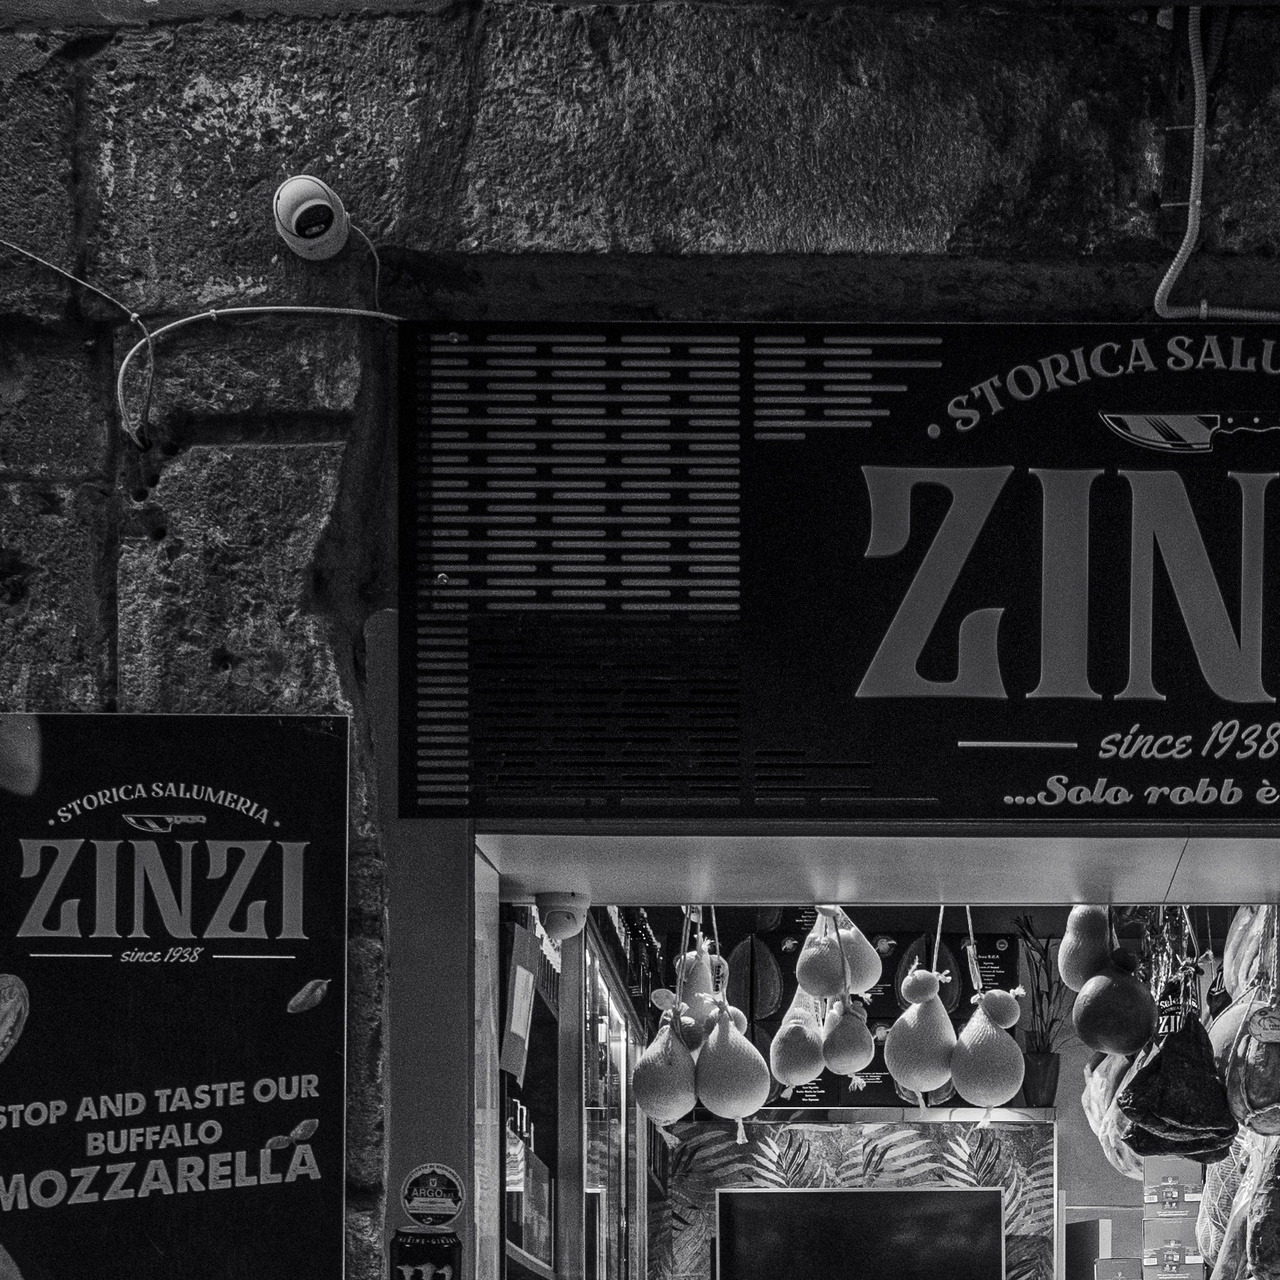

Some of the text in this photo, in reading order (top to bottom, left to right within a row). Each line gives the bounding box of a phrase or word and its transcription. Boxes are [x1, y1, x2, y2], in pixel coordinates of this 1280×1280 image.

[947, 343, 1157, 434] STORICA
[1098, 725, 1192, 760] since
[56, 781, 271, 826] STORICA SALUMERIA
[1144, 774, 1242, 806] robb
[1257, 776, 1280, 805] è
[16, 838, 310, 940] ZINZI
[120, 946, 204, 964] since 1938
[75, 1092, 146, 1122] AND
[155, 1081, 245, 1113] TASTE
[253, 1074, 320, 1103] OUR
[87, 1119, 223, 1156] BUFFALO
[0, 1144, 322, 1212] MOZZARELLA
[411, 1188, 443, 1198] ARGO
